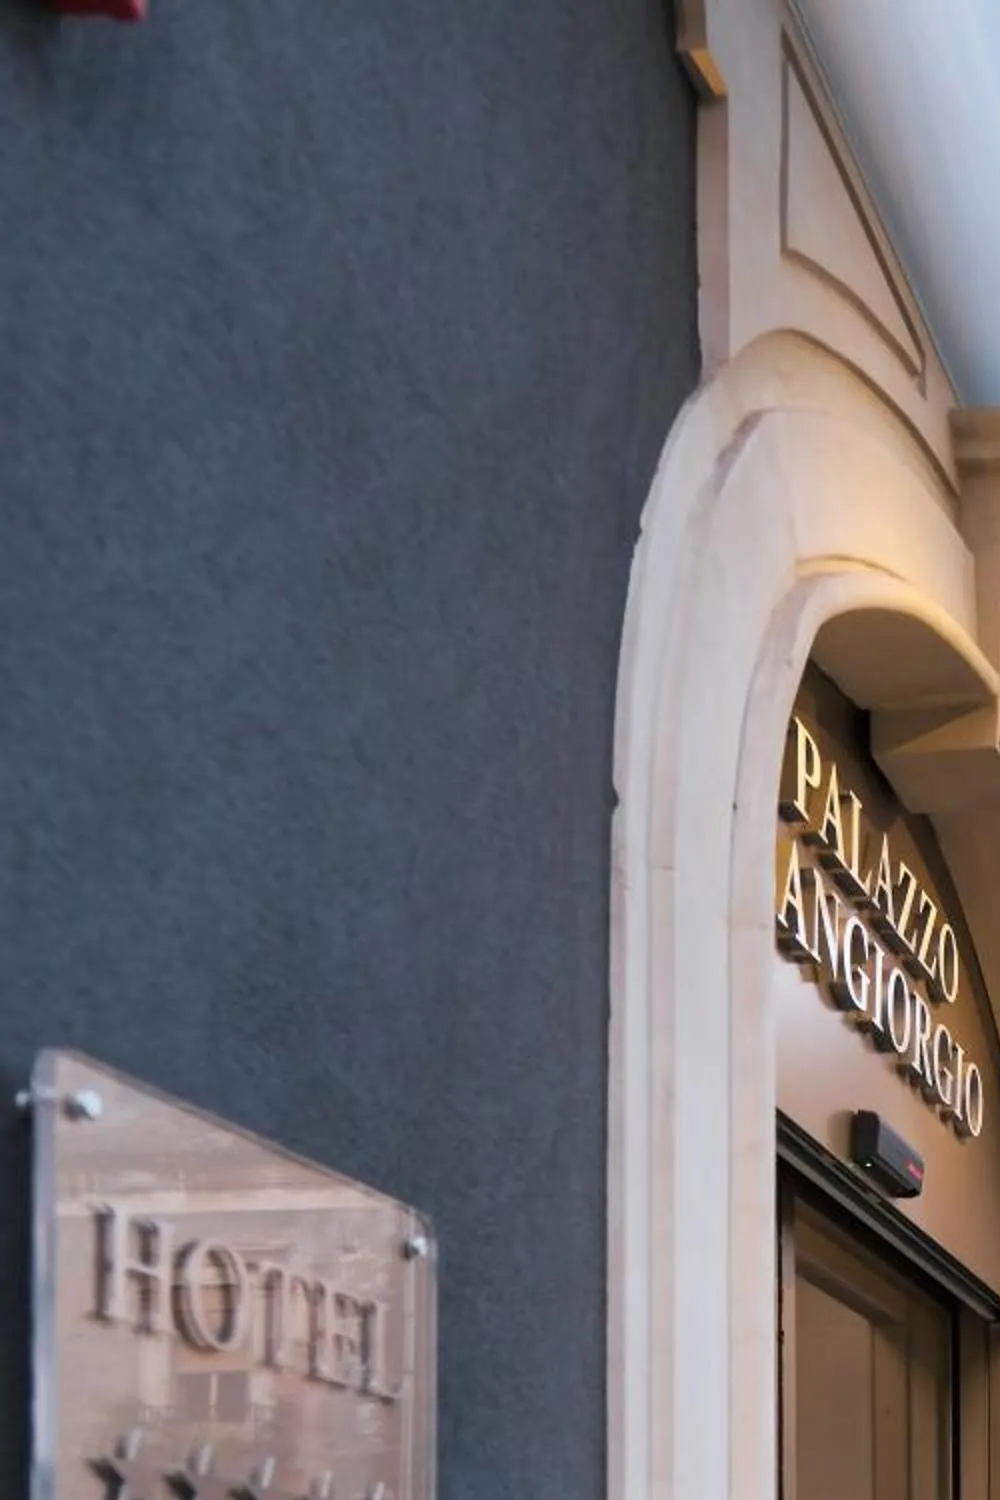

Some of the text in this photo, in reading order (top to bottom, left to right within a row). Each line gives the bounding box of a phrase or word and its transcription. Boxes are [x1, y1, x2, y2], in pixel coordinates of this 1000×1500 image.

[776, 838, 984, 1137] ANGIORGIO
[794, 717, 960, 1003] PALAZZO
[88, 1203, 404, 1404] HOTEL
